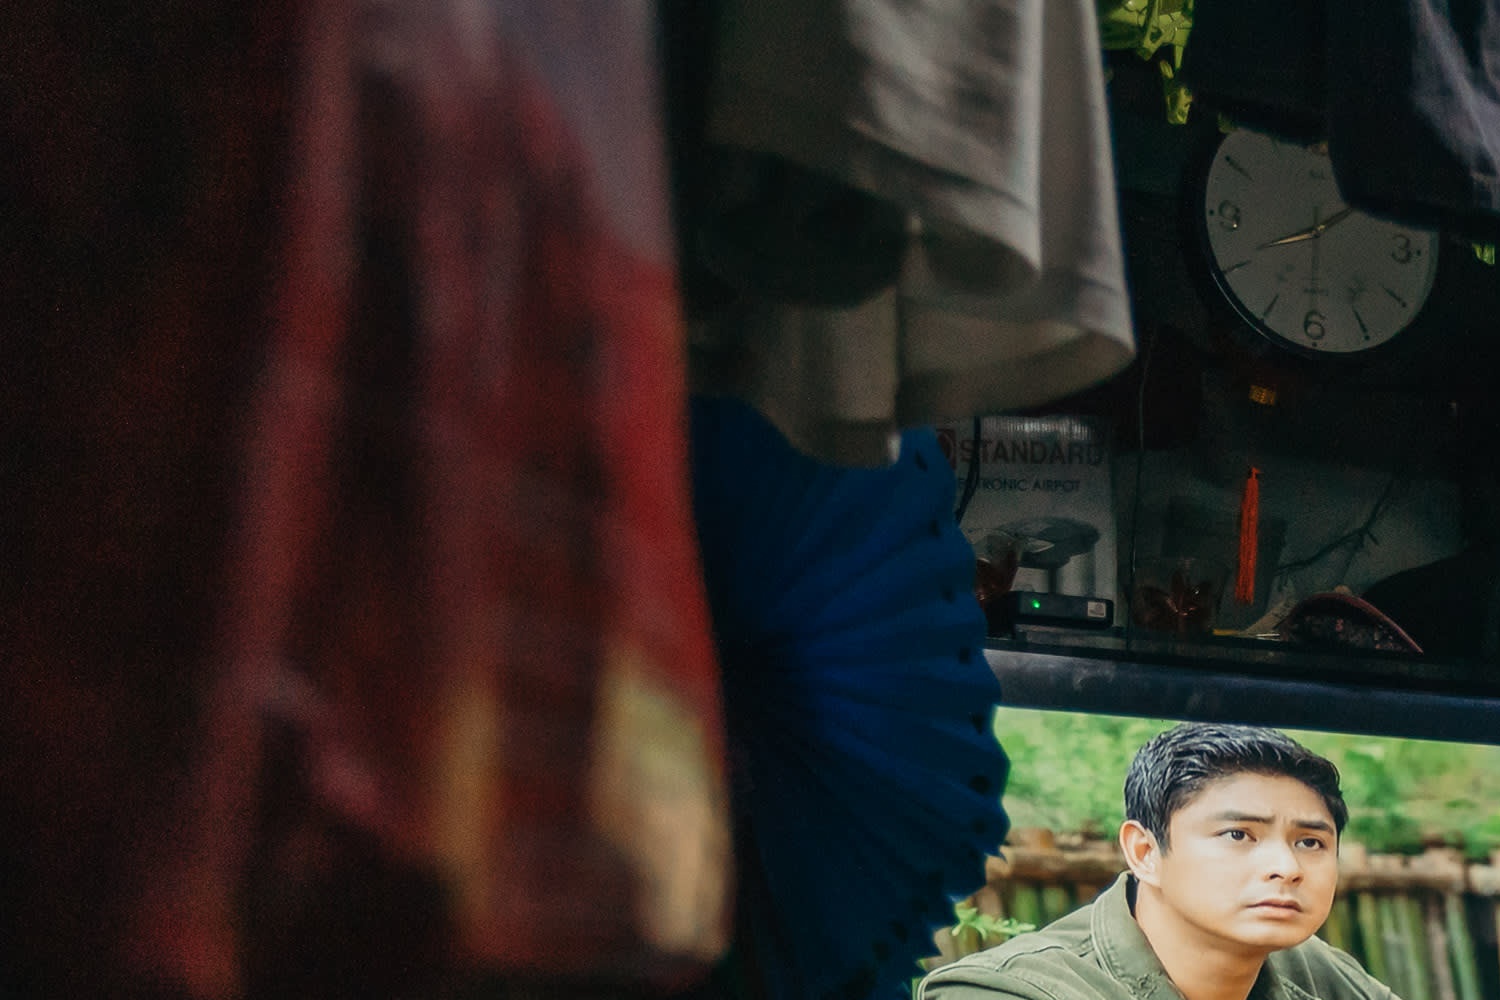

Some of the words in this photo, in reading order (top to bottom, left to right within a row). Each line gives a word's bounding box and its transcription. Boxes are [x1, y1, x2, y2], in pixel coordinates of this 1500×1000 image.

[1218, 200, 1241, 233] 9
[1391, 233, 1412, 265] 3
[1303, 309, 1326, 341] 6
[959, 439, 1105, 466] STANDARD
[1033, 478, 1082, 493] AIRPOT
